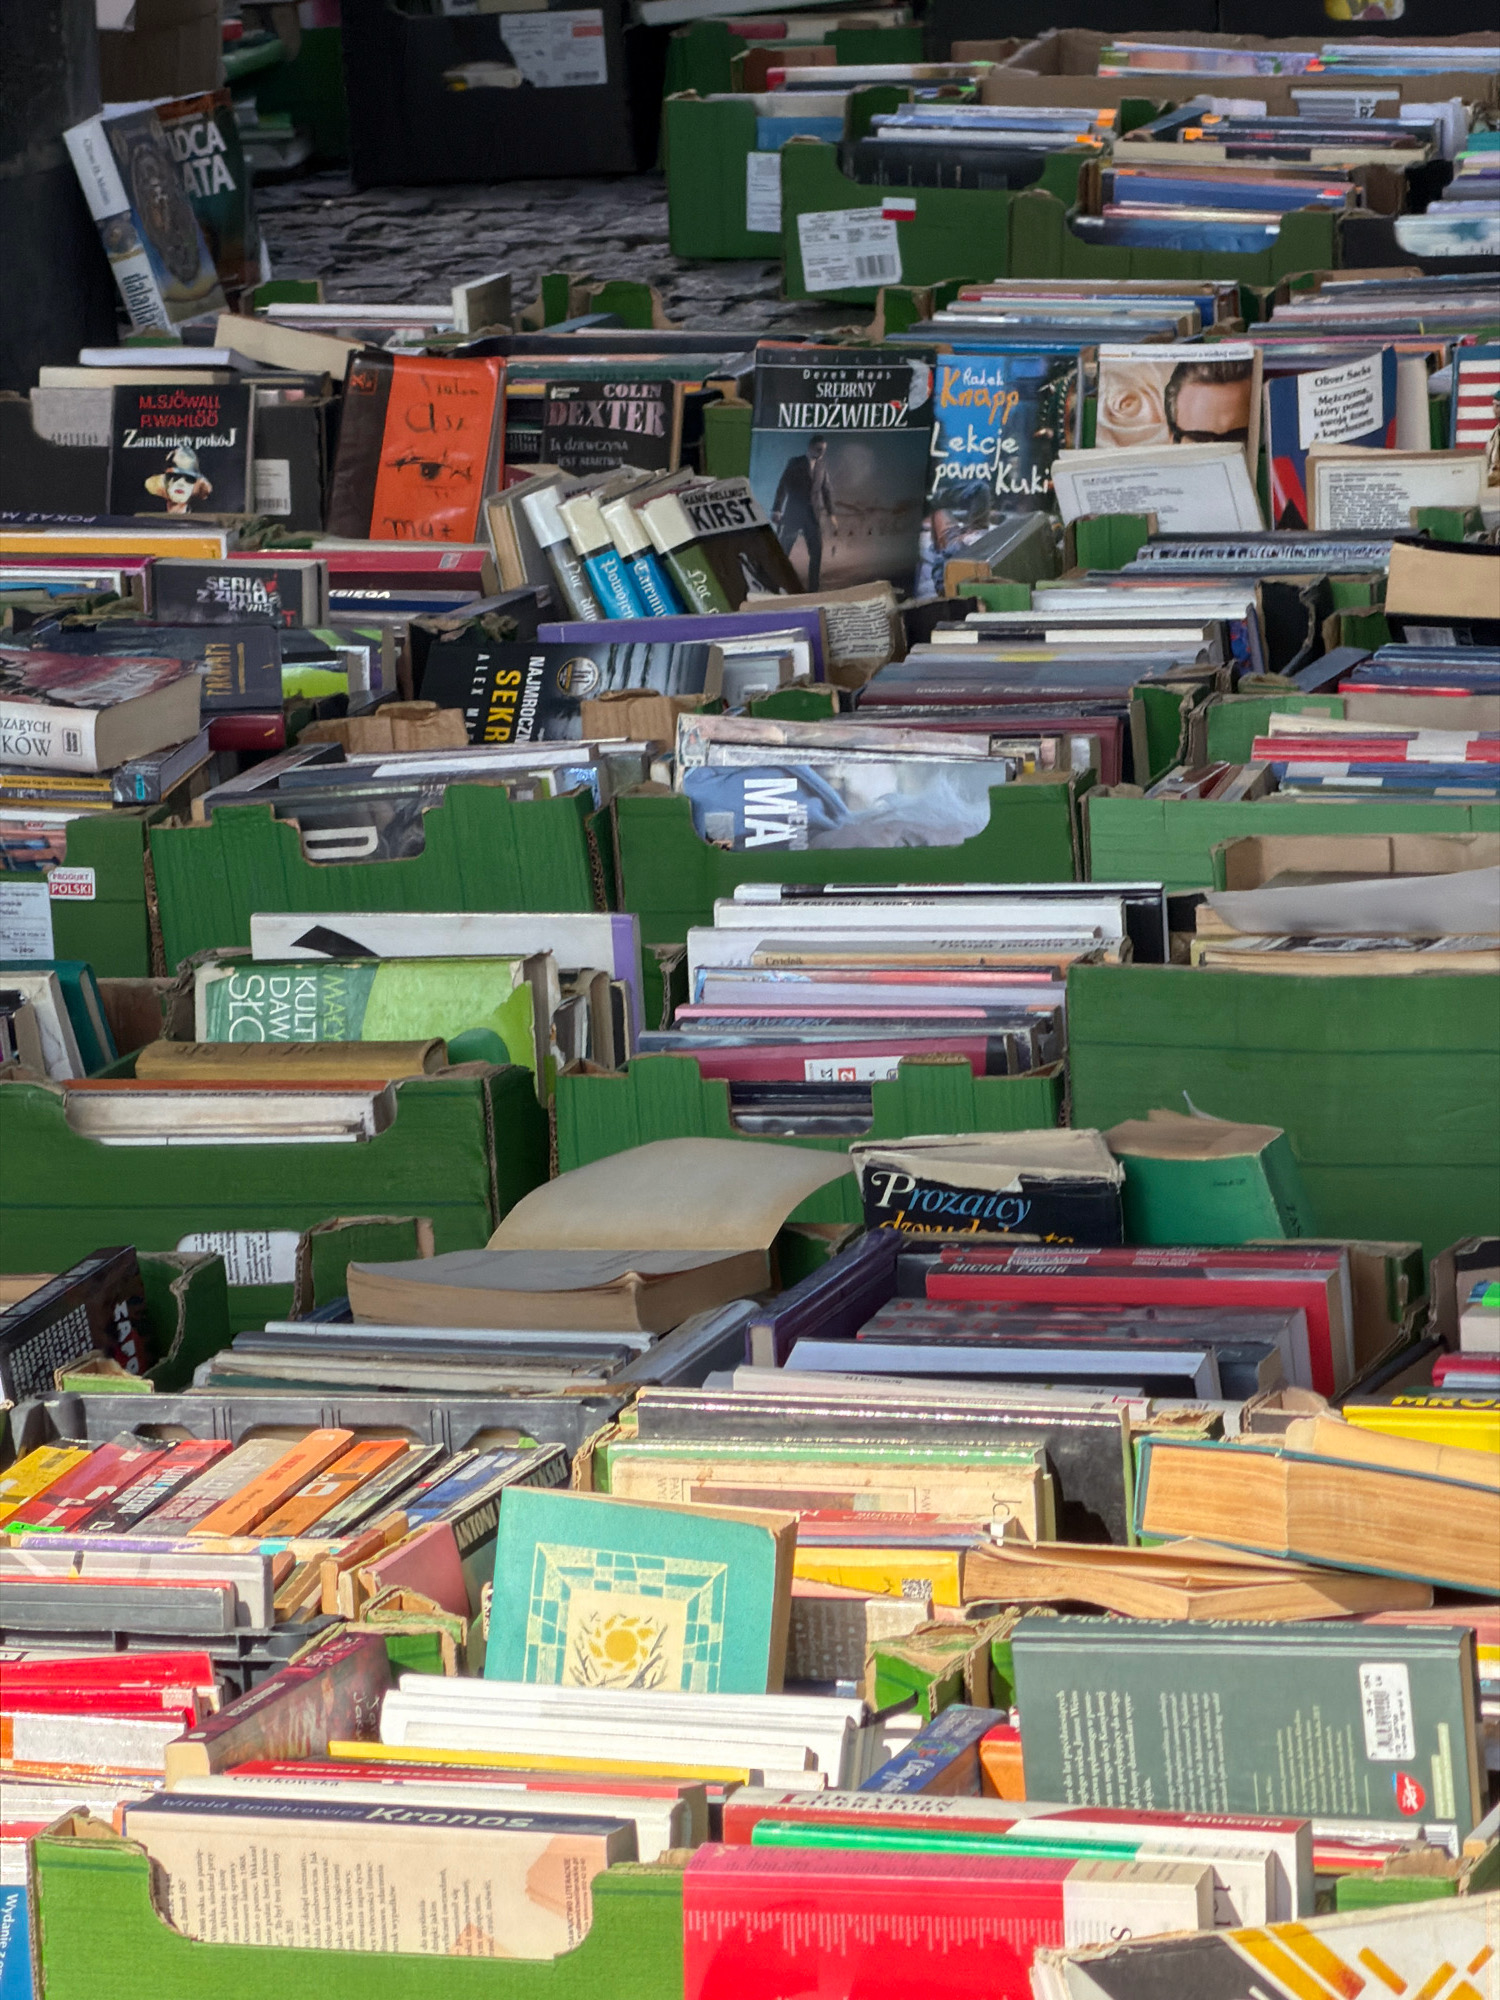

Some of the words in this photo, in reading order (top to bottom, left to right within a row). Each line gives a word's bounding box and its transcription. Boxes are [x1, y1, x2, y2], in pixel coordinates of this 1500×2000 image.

[167, 120, 227, 163] DCA
[603, 384, 662, 398] COLIN
[815, 381, 877, 398] SREBRNY
[1315, 374, 1344, 387] Oliver
[1347, 365, 1371, 378] Sacks
[778, 397, 909, 428] NIEDŹWIEDŹ
[940, 366, 1019, 425] Knapp
[548, 400, 665, 438] DEXTER
[930, 420, 1019, 471] Lekcje
[926, 461, 992, 500] pana
[995, 460, 1049, 496] Kuki
[687, 498, 758, 531] KIRST
[206, 577, 266, 591] SERIA
[471, 652, 488, 696] ALEX
[465, 707, 480, 742] MA
[51, 883, 93, 896] POLSKI
[295, 976, 317, 1041] KULT
[871, 1170, 1032, 1229] Prozaicy
[366, 1806, 535, 1831] Kronos
[1182, 1812, 1284, 1828] Edukacja
[0, 1893, 20, 1948] Wydanie
